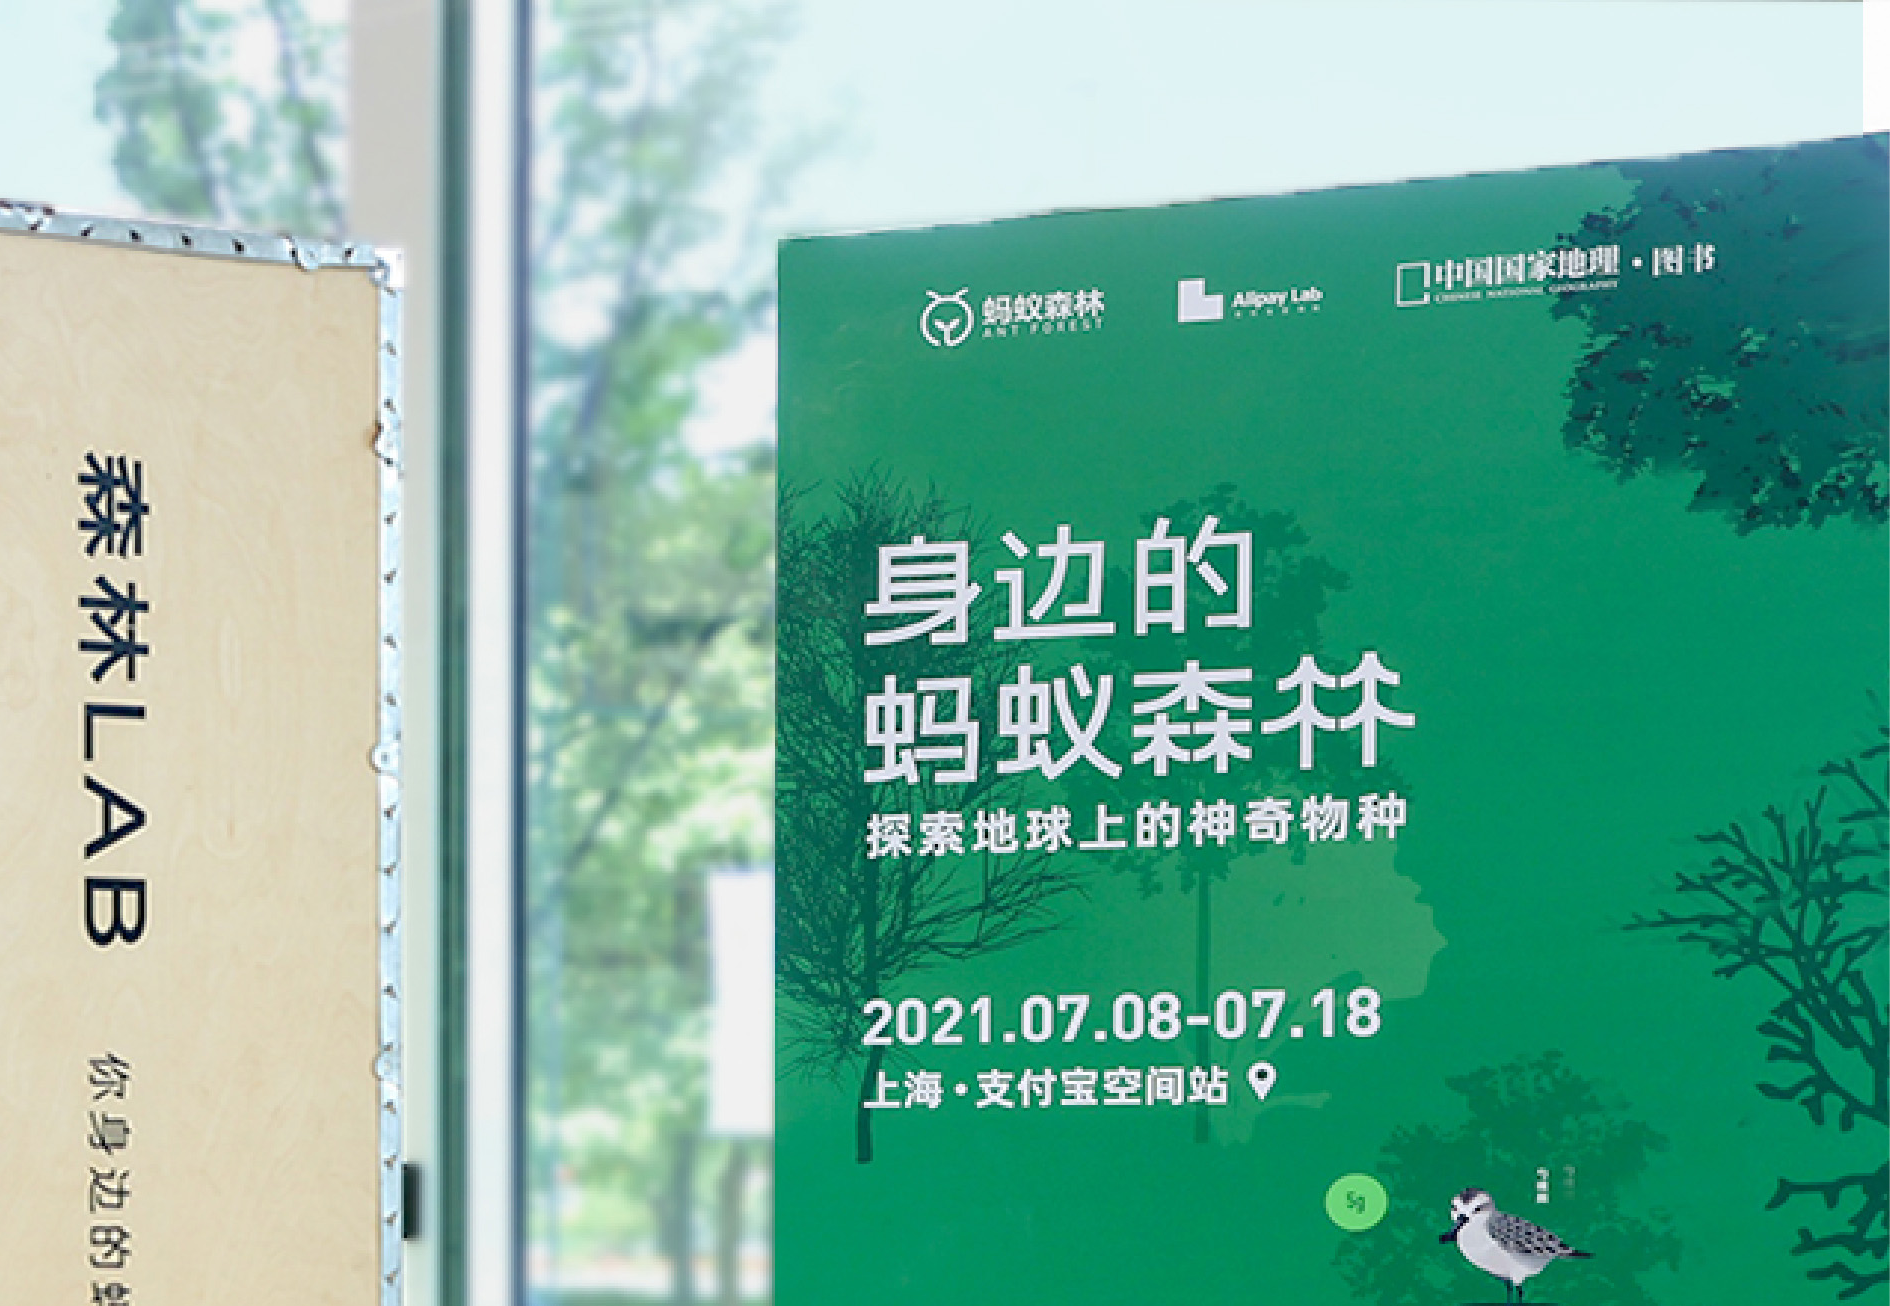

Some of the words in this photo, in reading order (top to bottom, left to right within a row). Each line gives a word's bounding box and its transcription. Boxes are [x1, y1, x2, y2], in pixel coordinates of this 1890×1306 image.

[981, 289, 1105, 325] 蚂蚁森林
[1231, 290, 1288, 308] Alipay
[1291, 286, 1323, 303] Lab
[863, 515, 1254, 646] 身边的
[863, 650, 1416, 783] 蚂蚁森林
[866, 790, 1407, 859] 探索地球上的神奇物种
[862, 986, 1382, 1047] 2021.07.08-07.18
[863, 1064, 1230, 1109] 上海·支付宝空间站
